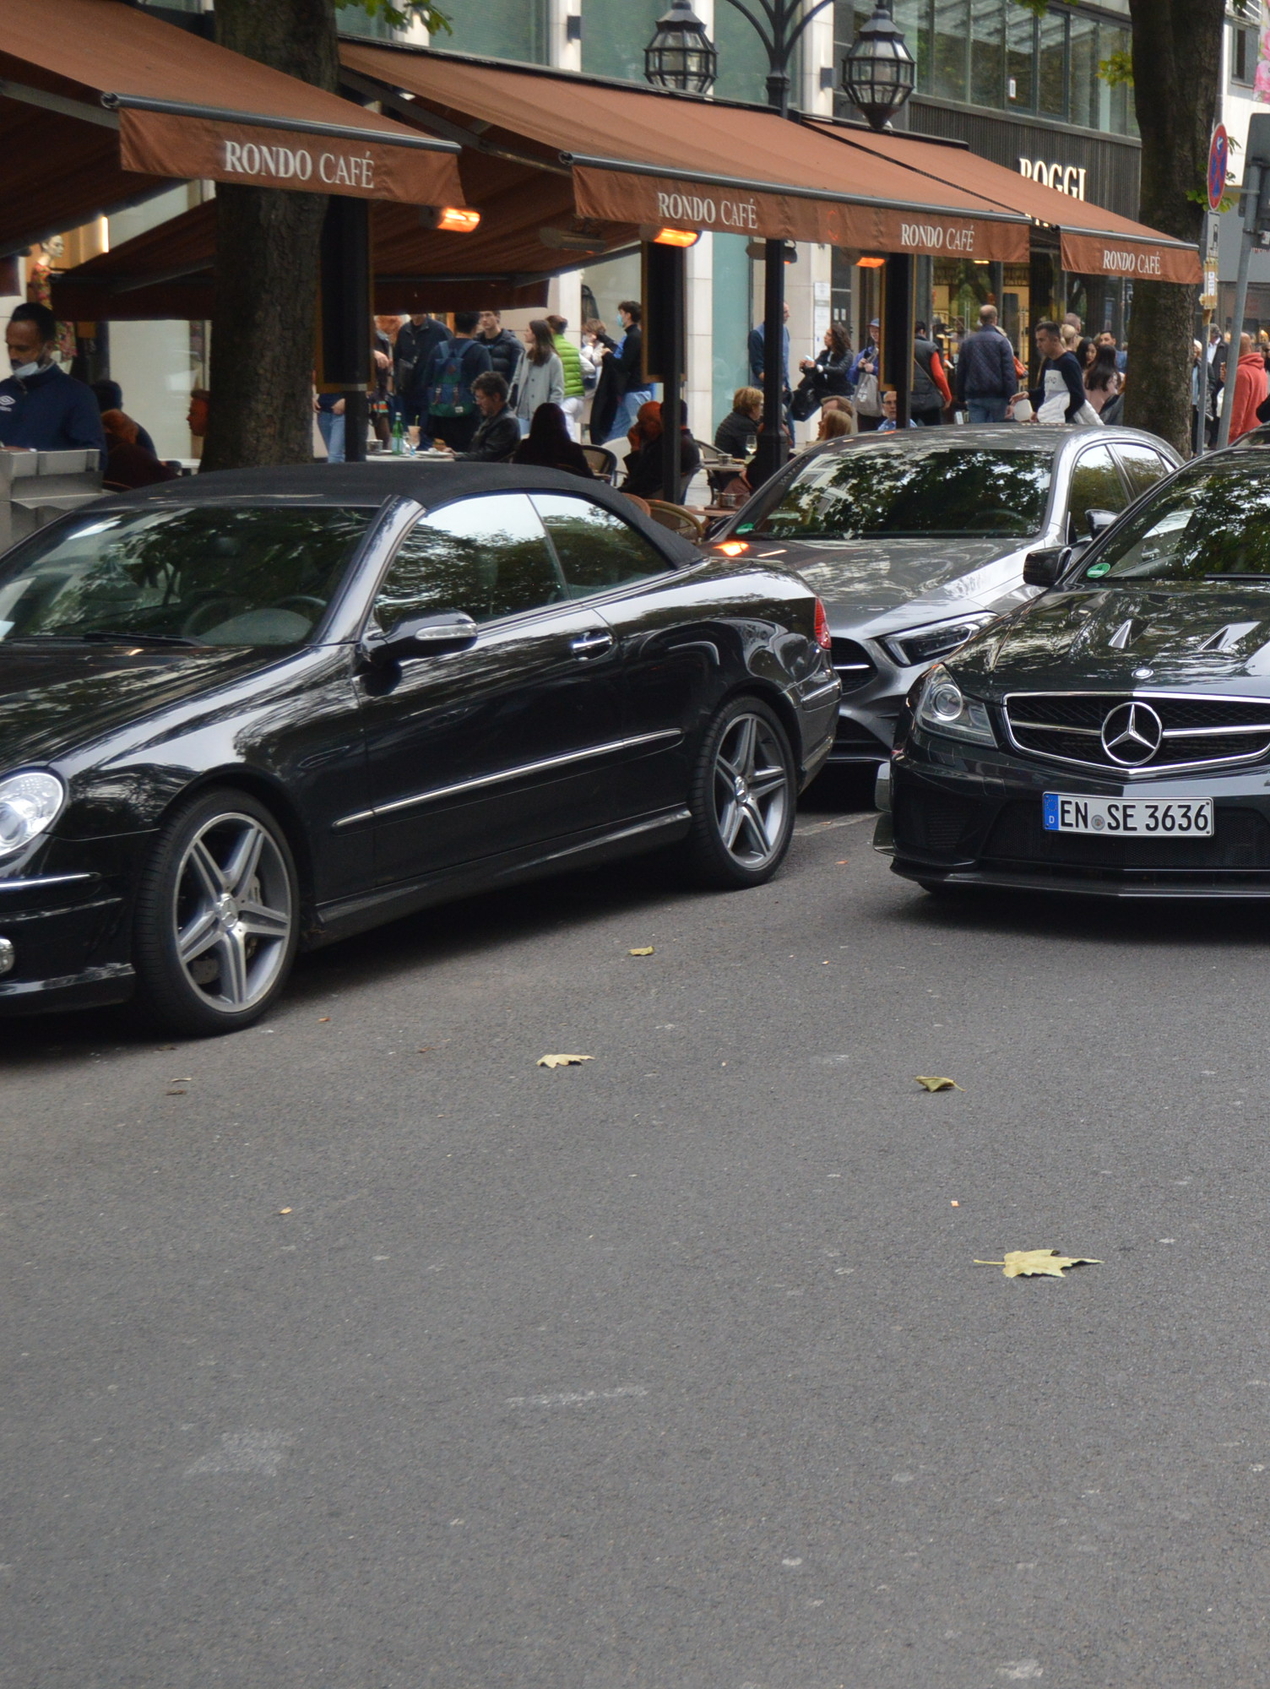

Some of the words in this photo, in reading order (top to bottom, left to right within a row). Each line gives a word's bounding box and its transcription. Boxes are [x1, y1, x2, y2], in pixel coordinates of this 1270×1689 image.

[224, 140, 312, 180] RONDO
[319, 150, 375, 188] CAFÉ
[658, 192, 716, 223] RONDO
[721, 198, 758, 229] CAFÉ
[901, 223, 943, 249] RONDO
[946, 224, 974, 252] CAFÉ
[1103, 249, 1135, 271] RONDO
[1137, 251, 1161, 275] CAFÉ
[1048, 815, 1055, 823] D
[1060, 800, 1089, 829] EN
[1107, 804, 1138, 832] SE
[1145, 804, 1209, 832] 3636
